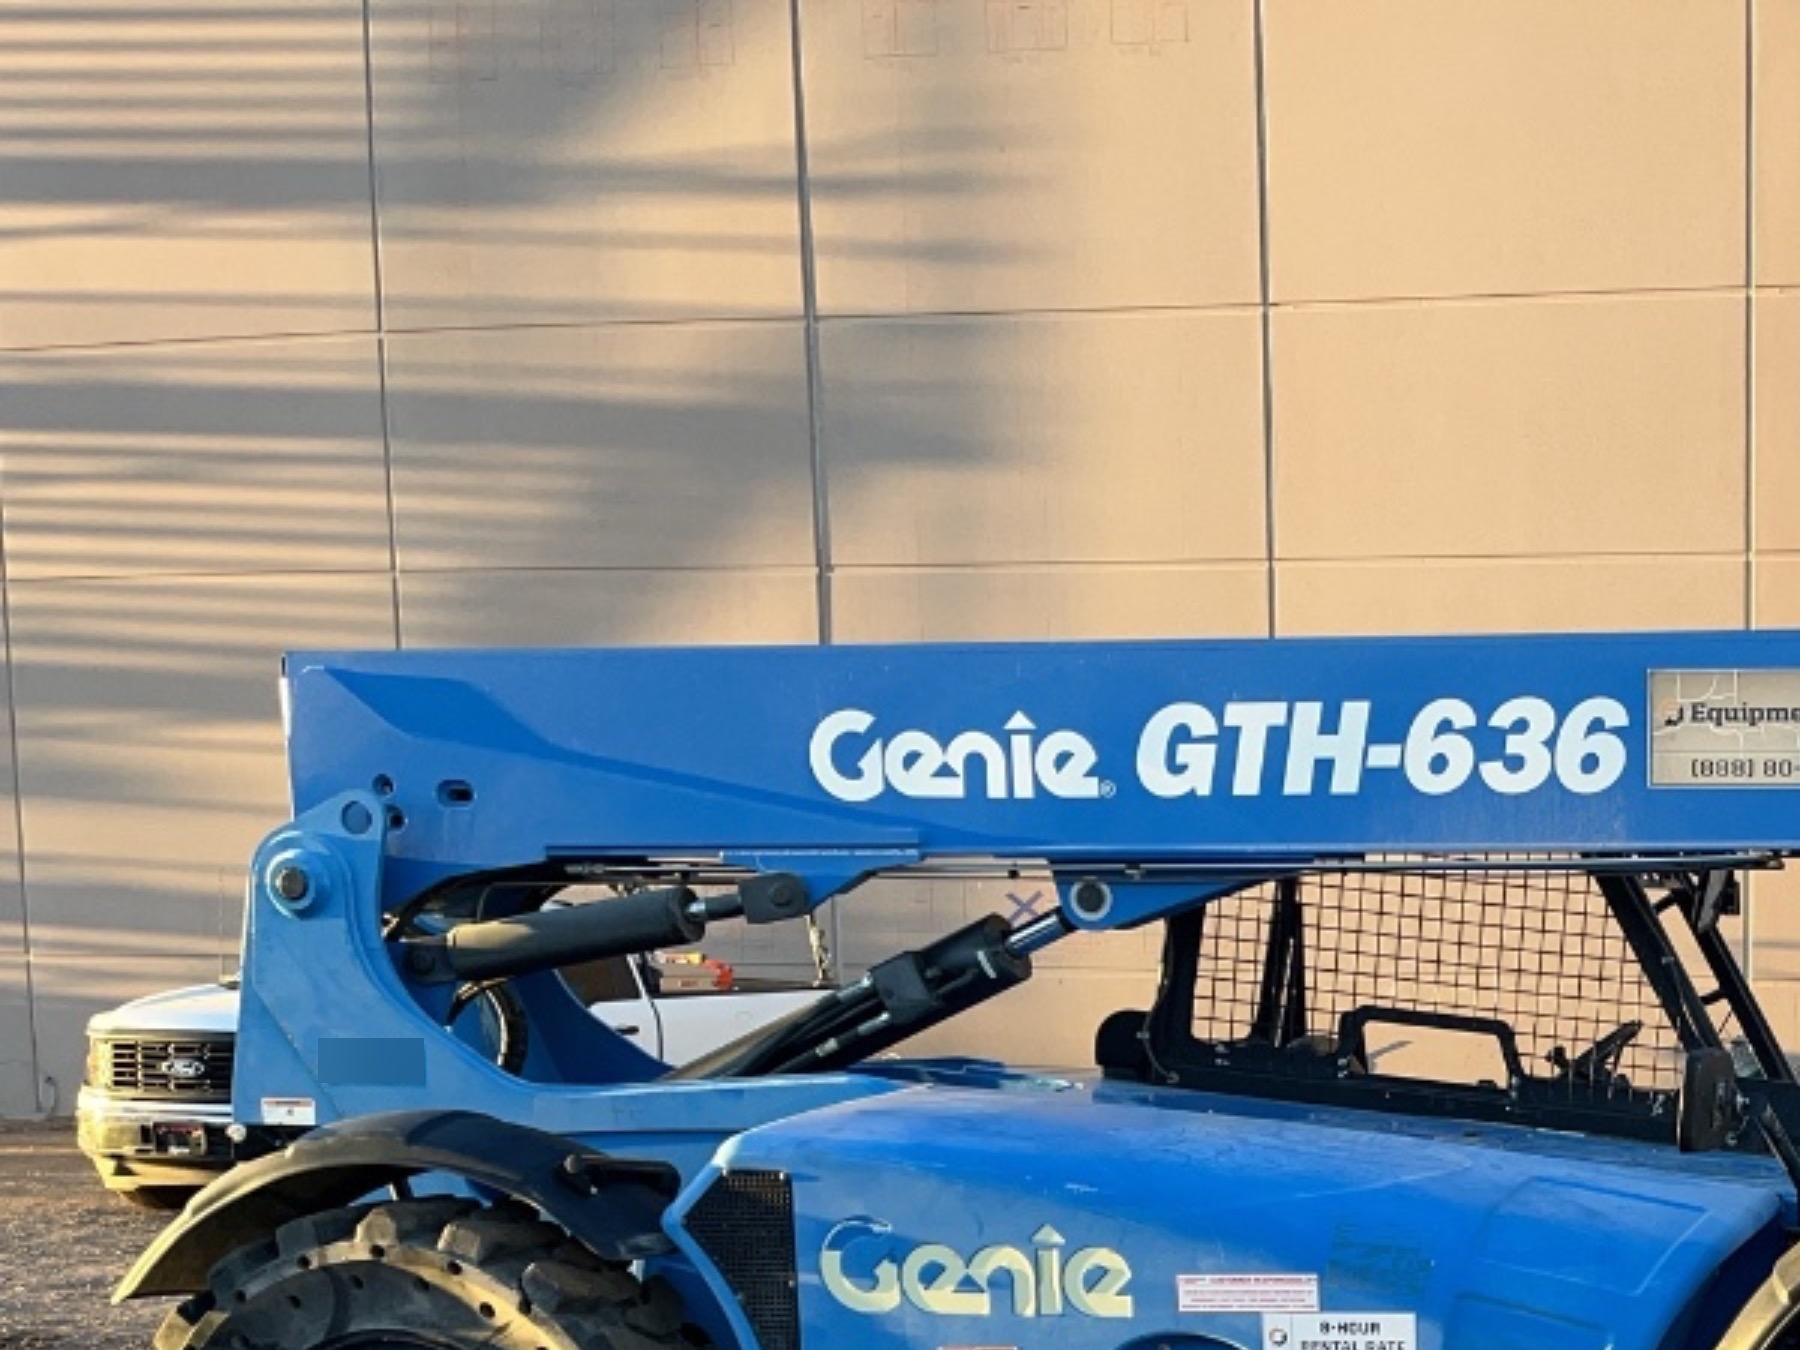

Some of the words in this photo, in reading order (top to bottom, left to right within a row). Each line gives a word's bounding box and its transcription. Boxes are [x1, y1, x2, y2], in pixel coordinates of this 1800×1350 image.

[809, 708, 1100, 801] Genie
[1136, 696, 1630, 796] GTH-636
[820, 1218, 1134, 1318] Genie
